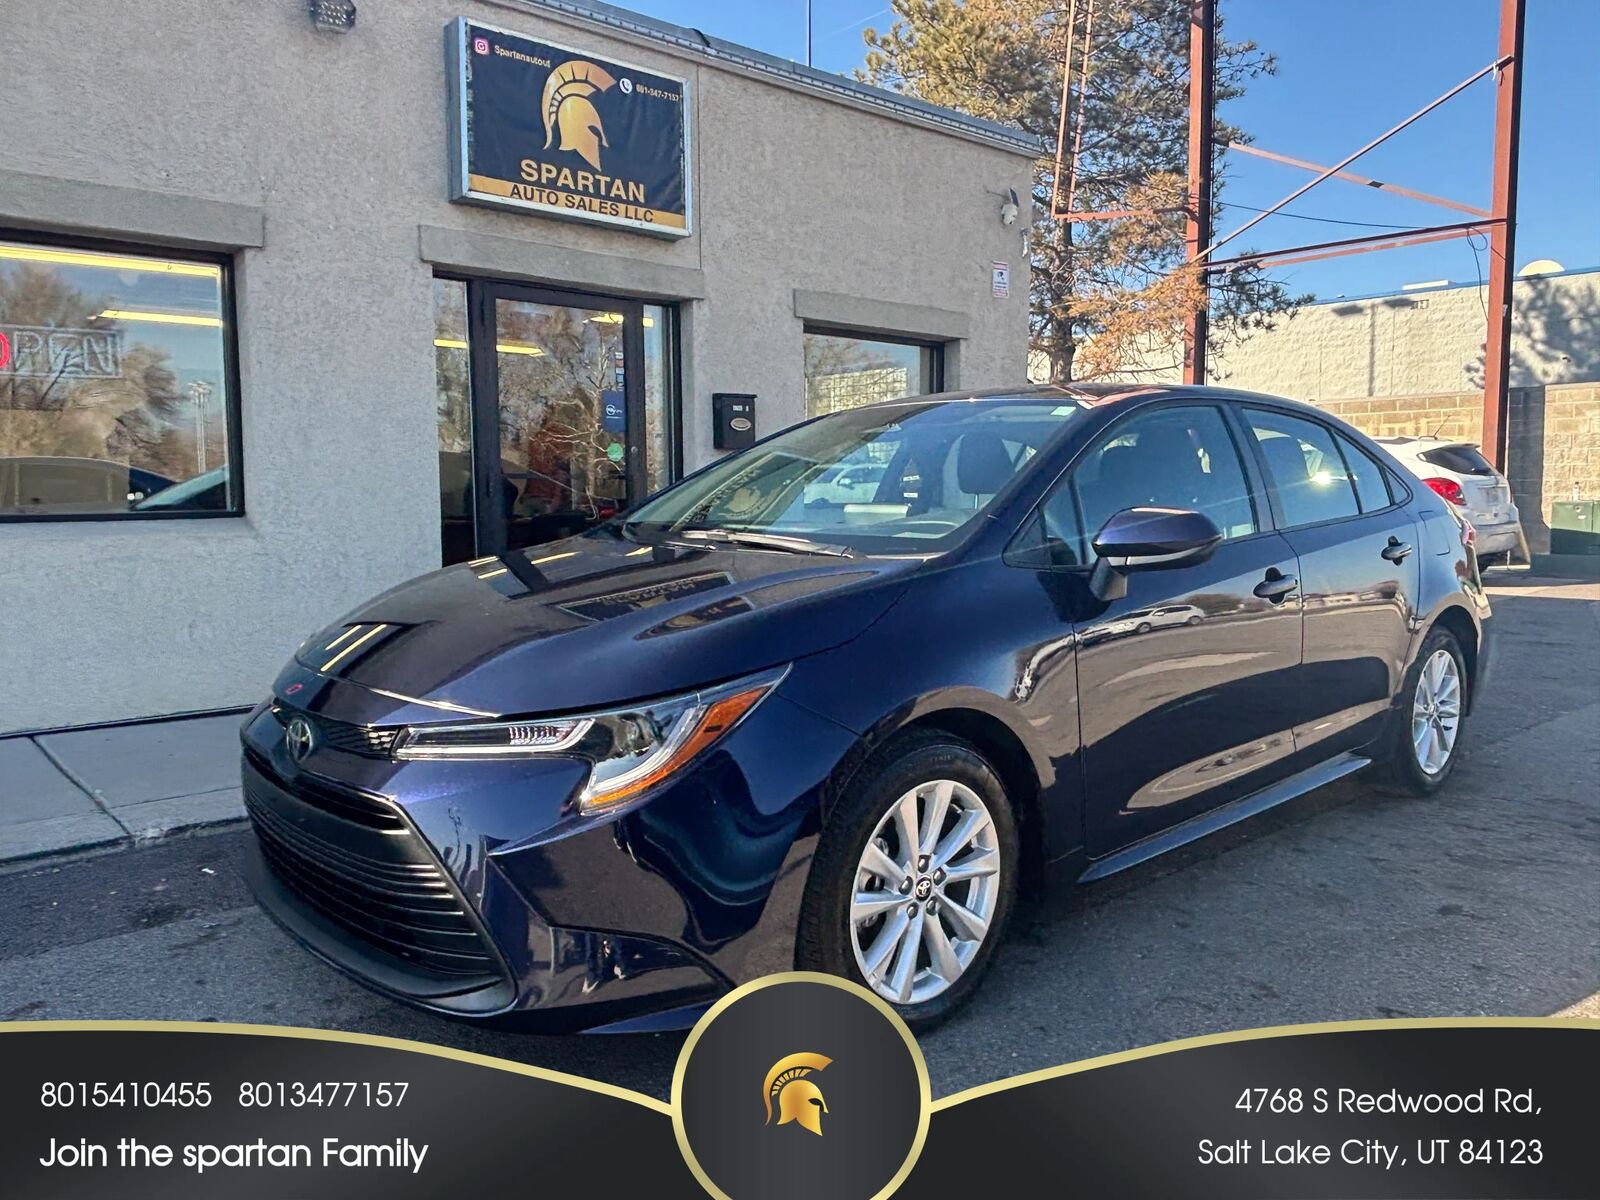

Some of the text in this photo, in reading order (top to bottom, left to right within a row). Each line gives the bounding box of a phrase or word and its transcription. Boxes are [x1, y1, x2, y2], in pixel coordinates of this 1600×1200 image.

[520, 159, 646, 204] SPARTAN
[510, 184, 655, 223] AUTO SALES LLC
